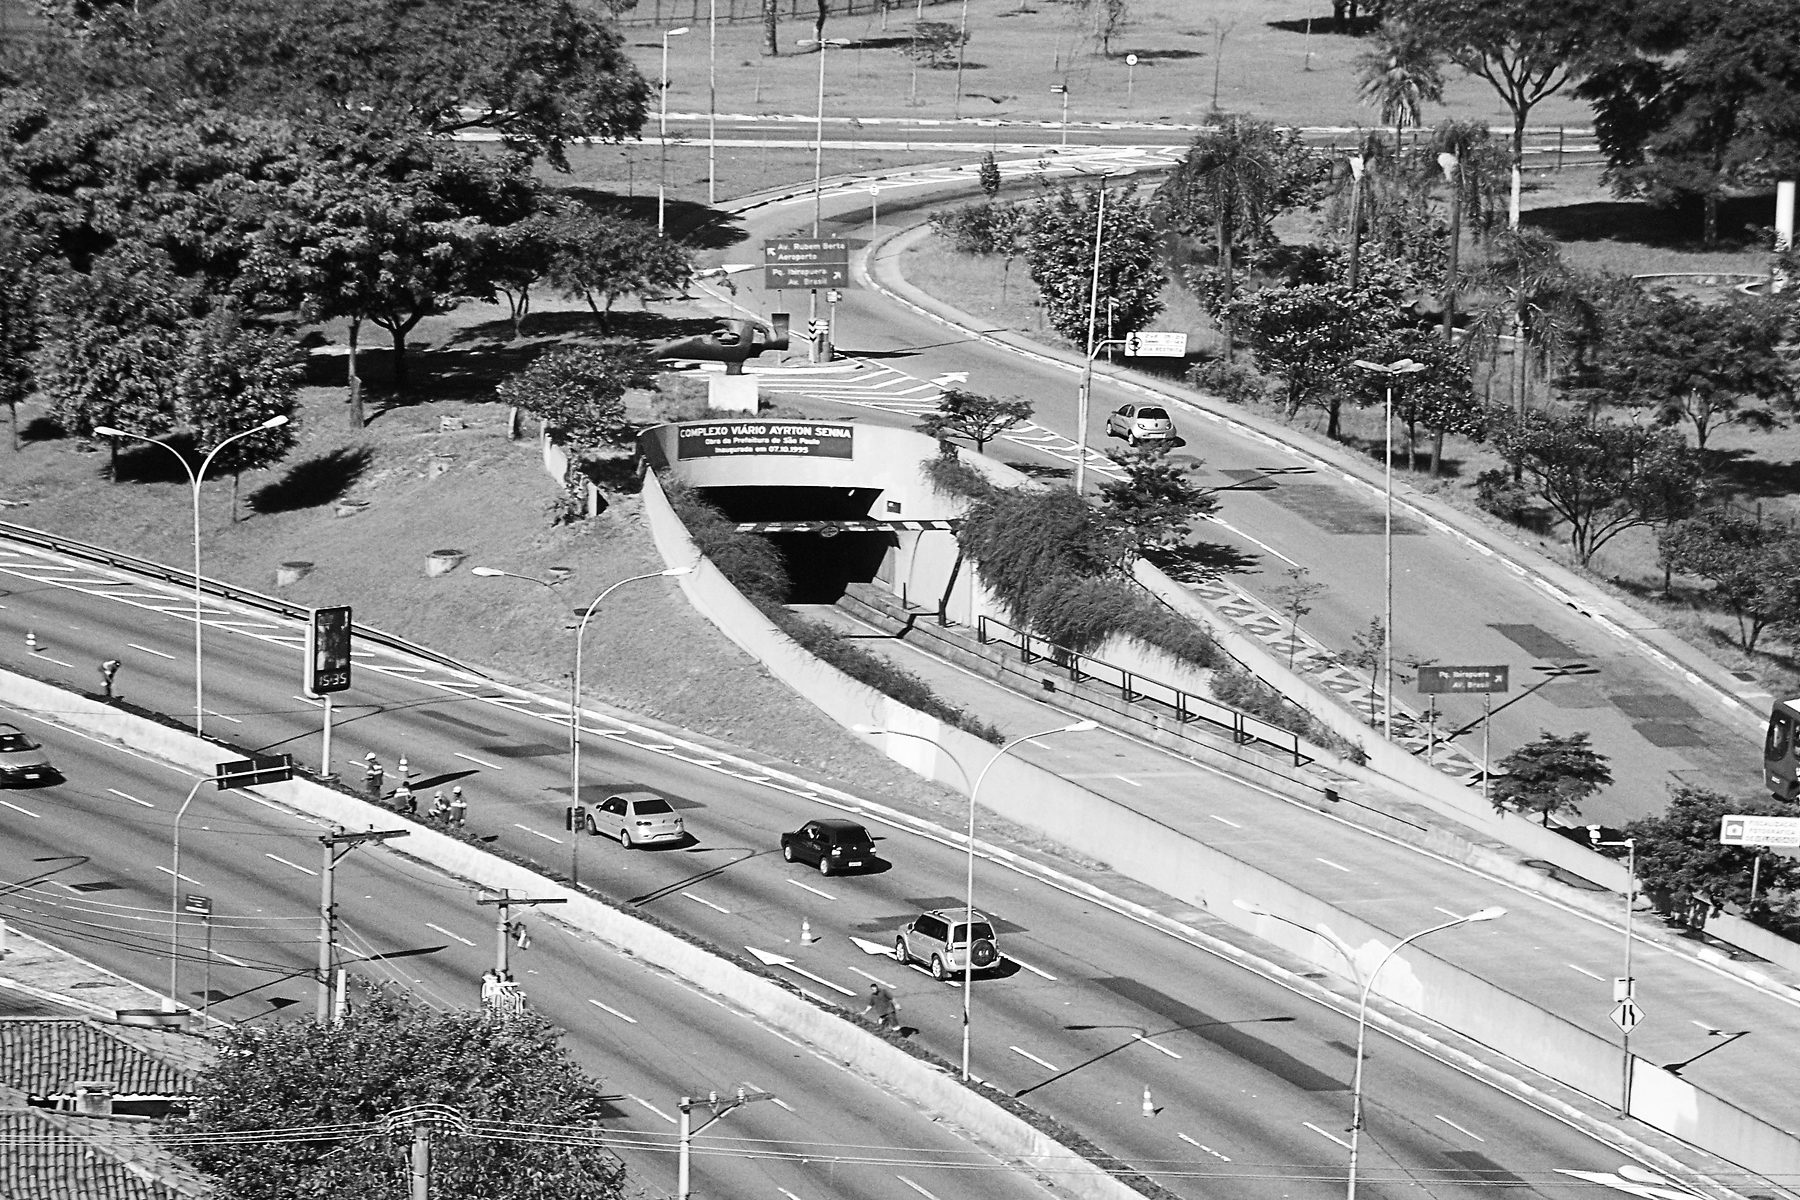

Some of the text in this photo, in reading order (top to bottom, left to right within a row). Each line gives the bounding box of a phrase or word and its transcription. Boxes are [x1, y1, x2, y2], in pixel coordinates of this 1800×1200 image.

[787, 268, 827, 276] Ibirapuera
[680, 424, 851, 438] COMPLEXO VIÁRIO AYRTON SENNA
[783, 436, 797, 444] São
[799, 437, 820, 445] Paulo
[768, 445, 809, 453] 07.10.1995
